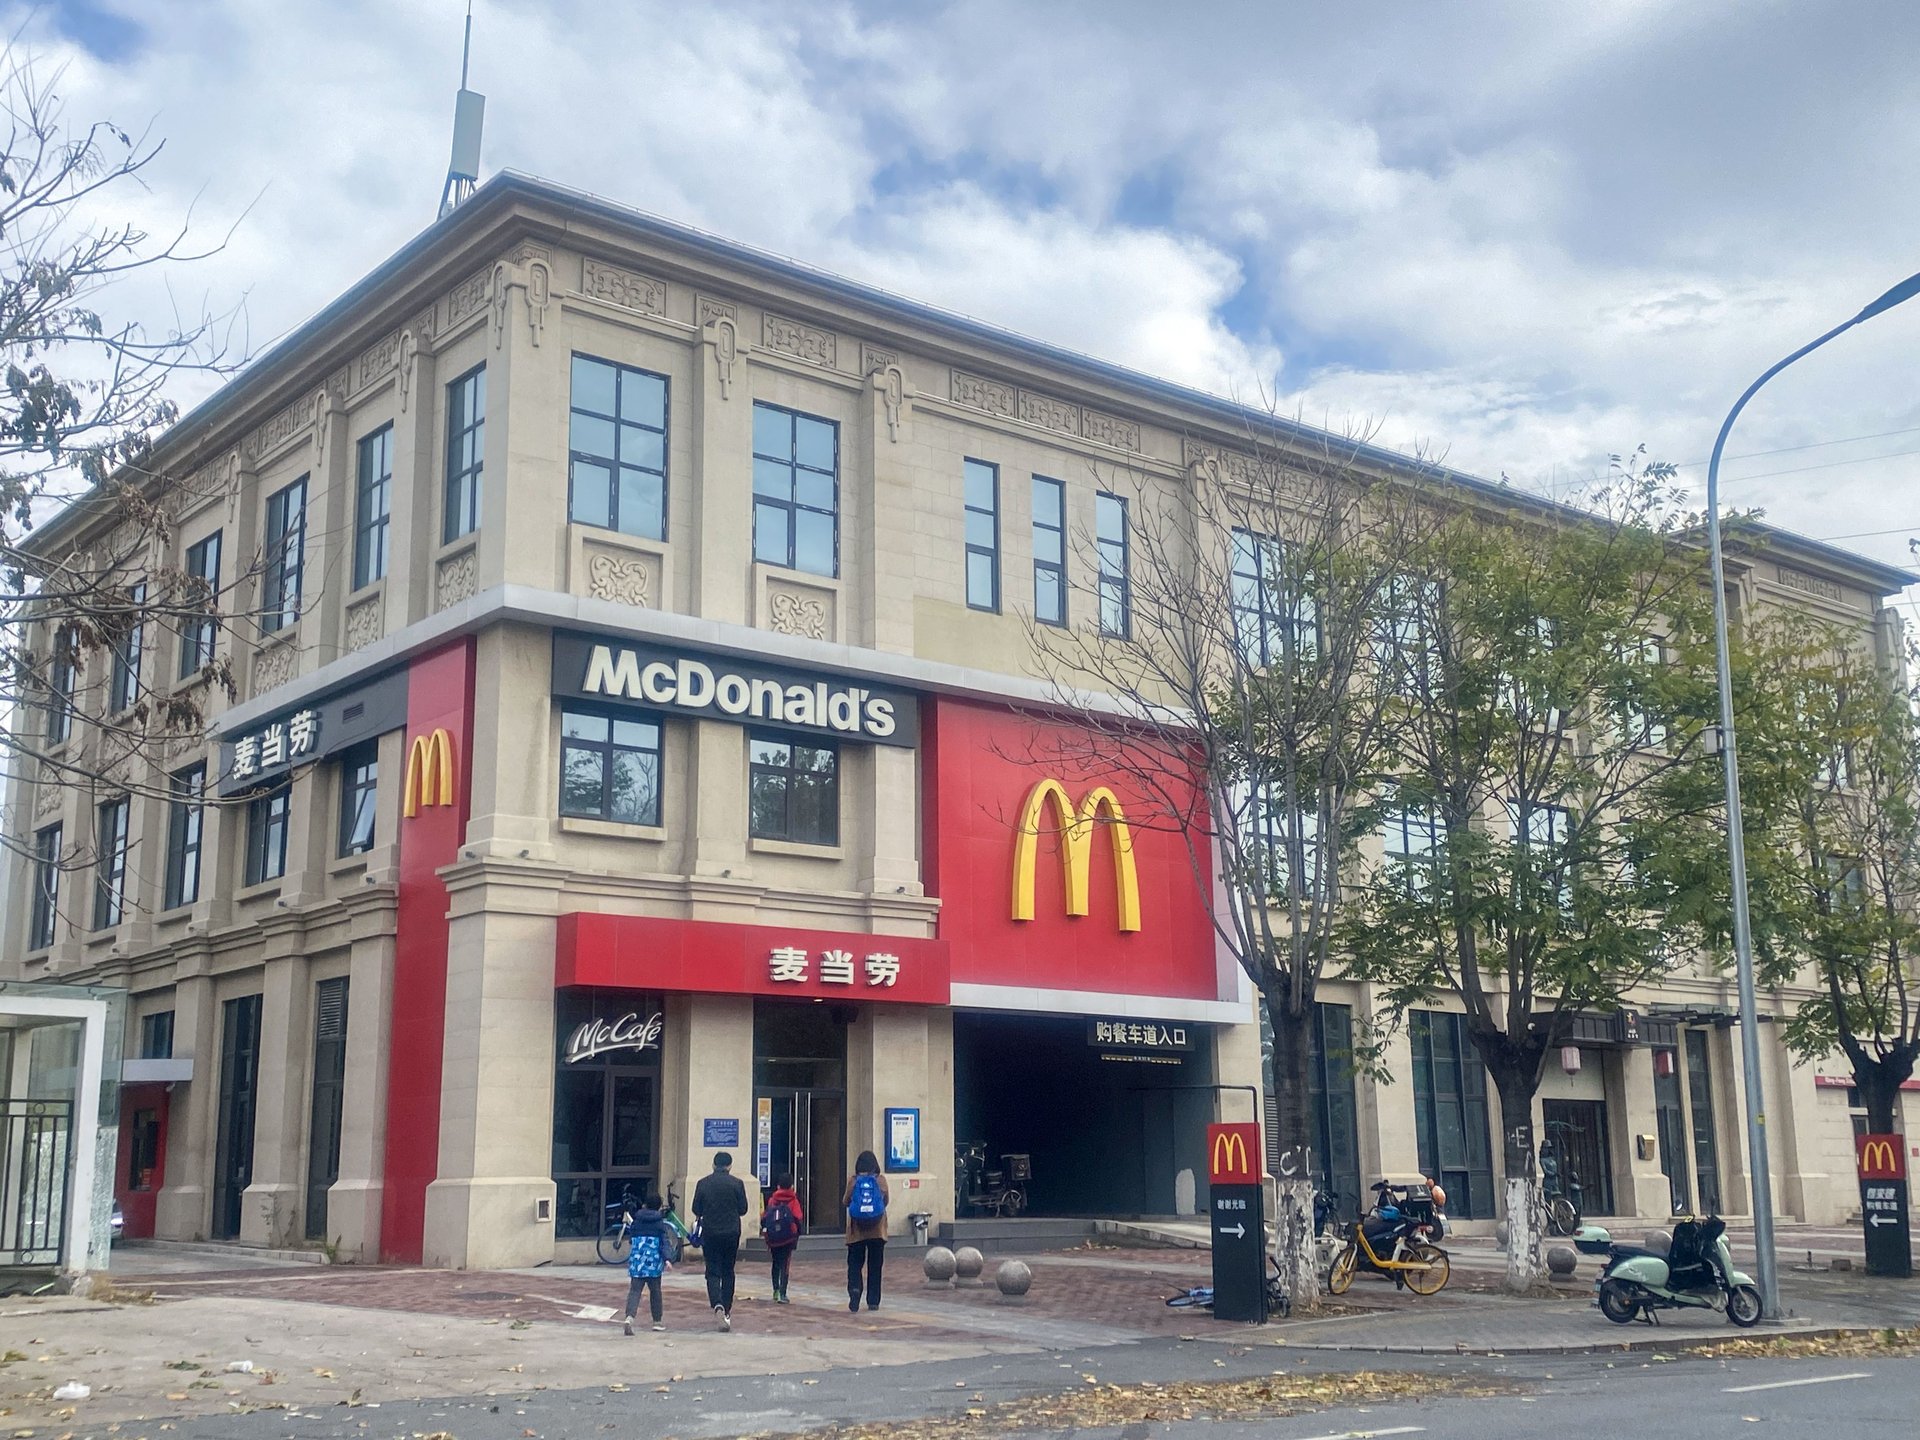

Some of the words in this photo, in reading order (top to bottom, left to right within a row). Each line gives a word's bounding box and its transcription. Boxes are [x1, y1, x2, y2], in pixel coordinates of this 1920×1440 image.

[583, 645, 897, 737] McDonald's
[233, 709, 317, 780] 麦当劳
[769, 946, 901, 987] 麦当劳
[571, 1012, 663, 1060] McCafé
[1096, 1021, 1187, 1046] 购餐车道入口
